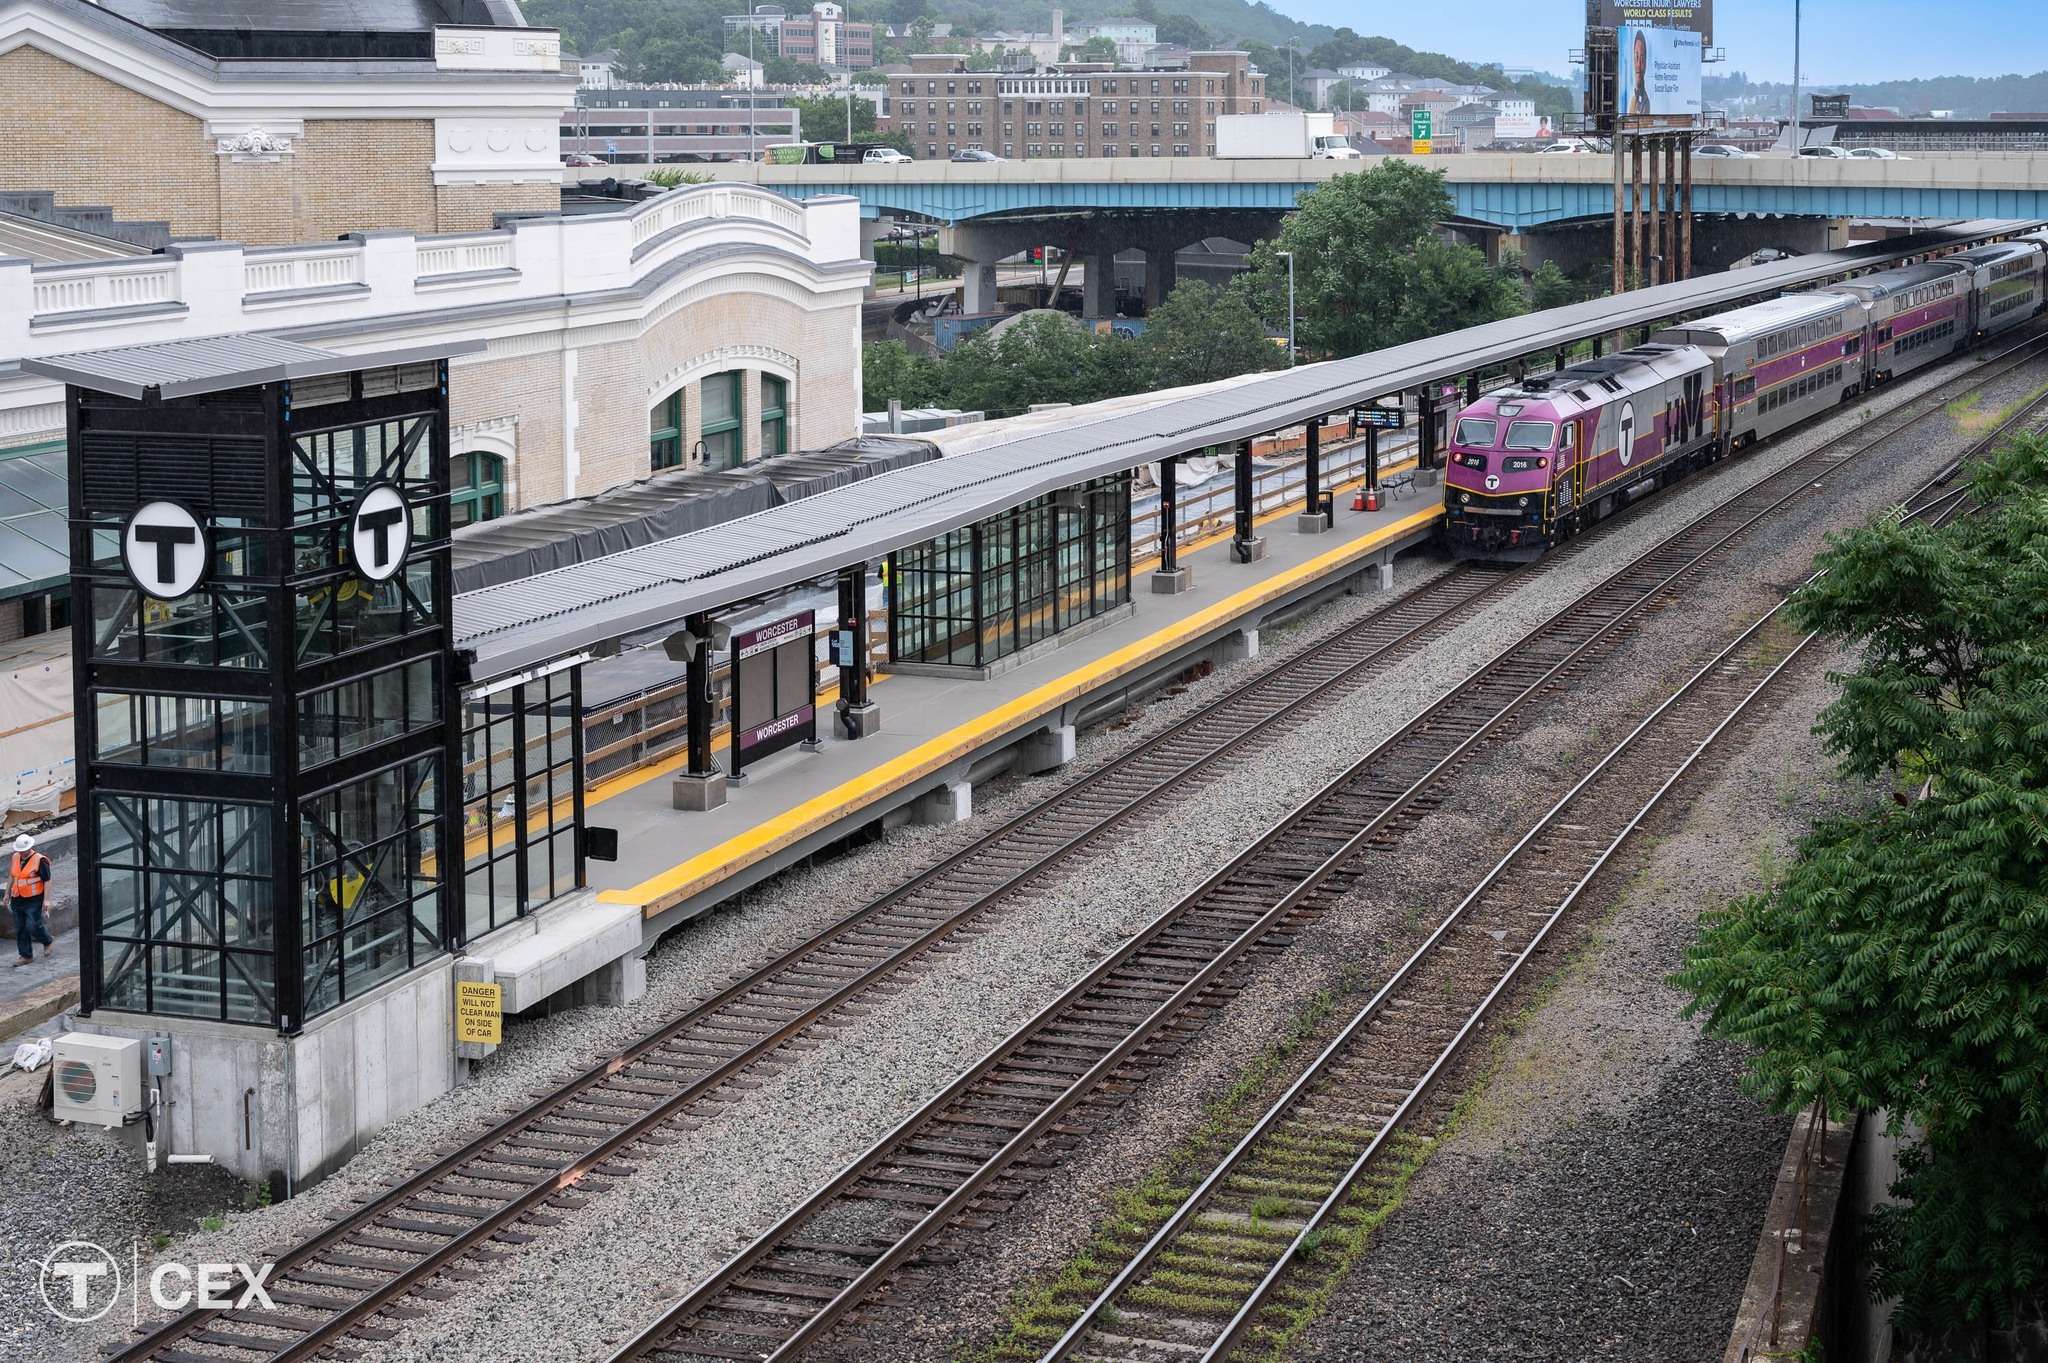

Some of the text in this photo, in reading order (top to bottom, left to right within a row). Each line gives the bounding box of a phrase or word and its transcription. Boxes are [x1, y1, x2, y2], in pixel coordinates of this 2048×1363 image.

[1674, 0, 1701, 8] LAWYERS
[1623, 9, 1646, 17] WORLD
[1647, 9, 1666, 17] CLASS
[1621, 417, 1633, 457] T
[1467, 458, 1480, 466] 2016
[1513, 461, 1528, 469] 2016
[1487, 478, 1498, 488] T
[358, 506, 403, 568] T
[135, 524, 196, 584] T
[756, 618, 798, 643] WORCESTER
[756, 714, 799, 741] WORCESTER
[462, 987, 495, 996] DANGER
[463, 999, 479, 1007] WILL
[461, 1008, 500, 1018] CLEAR MAN
[465, 1018, 492, 1027] ON SIDE
[466, 1028, 492, 1037] OF CAR
